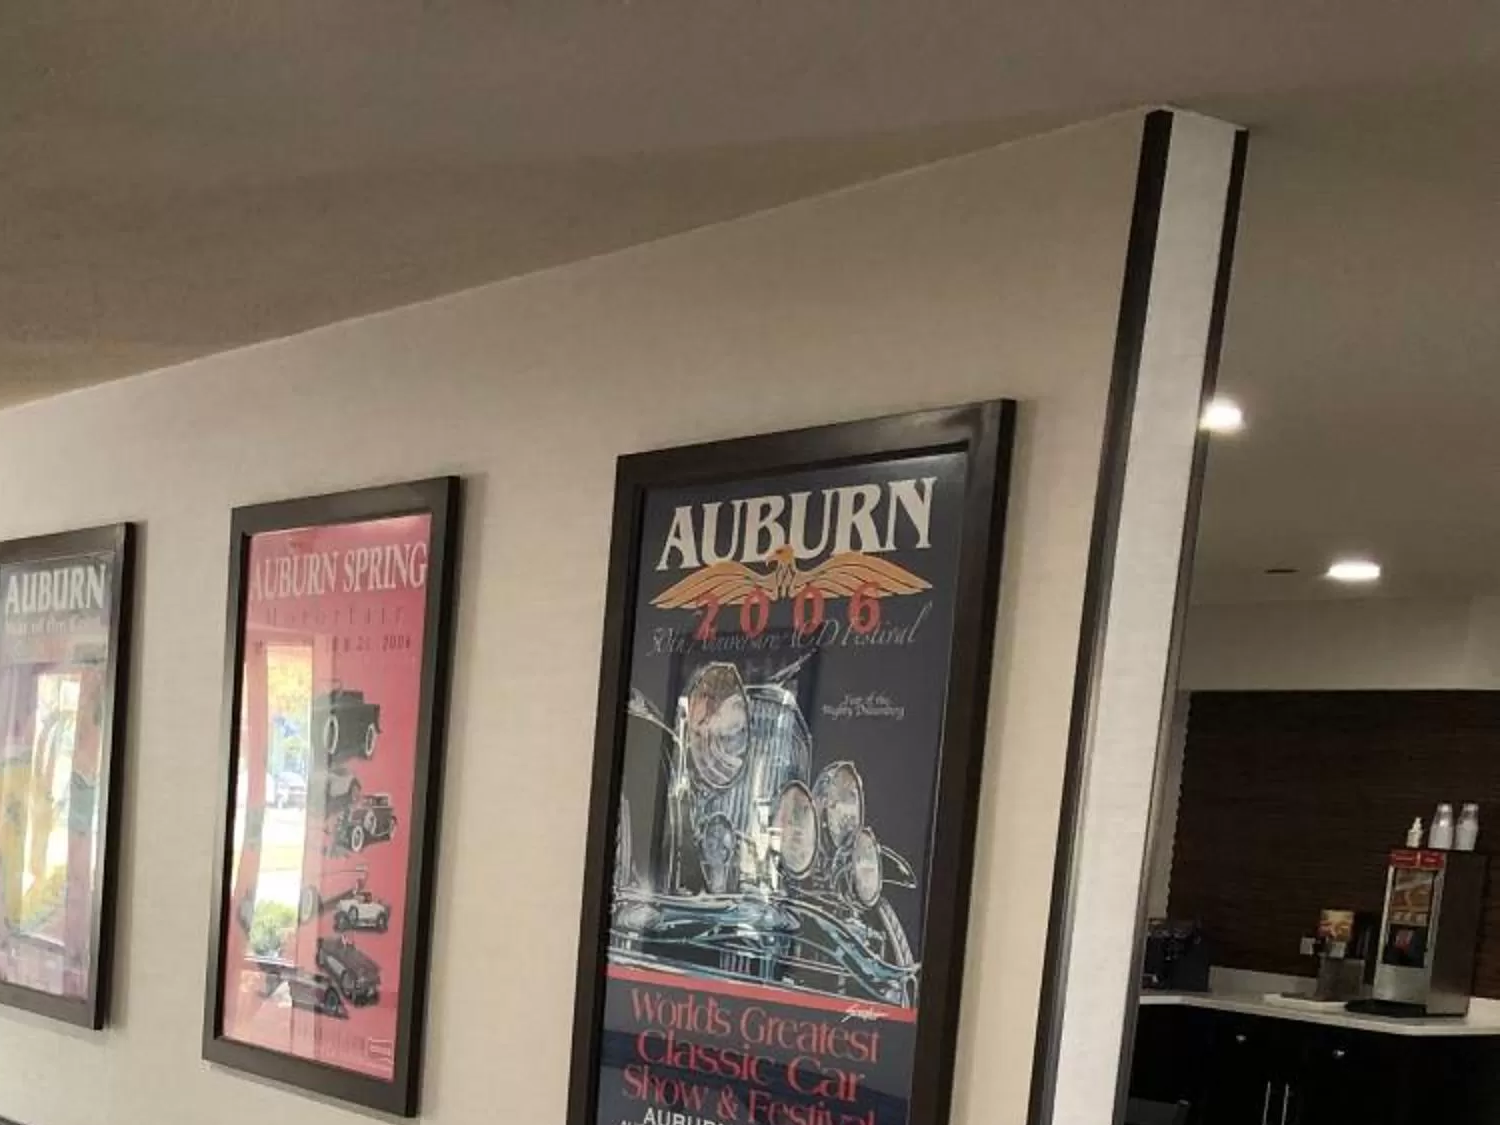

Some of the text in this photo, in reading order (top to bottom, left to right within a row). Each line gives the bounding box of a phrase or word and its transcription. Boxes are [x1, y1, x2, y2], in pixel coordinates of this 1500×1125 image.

[656, 477, 937, 572] AUBURN
[5, 564, 106, 614] AUBURN
[251, 540, 428, 601] AUBURN SPRING
[693, 582, 881, 640] 2006
[739, 1006, 880, 1064] Greatest
[622, 1064, 710, 1111] Show
[716, 1085, 739, 1120] &
[636, 1030, 864, 1102] Classic Car
